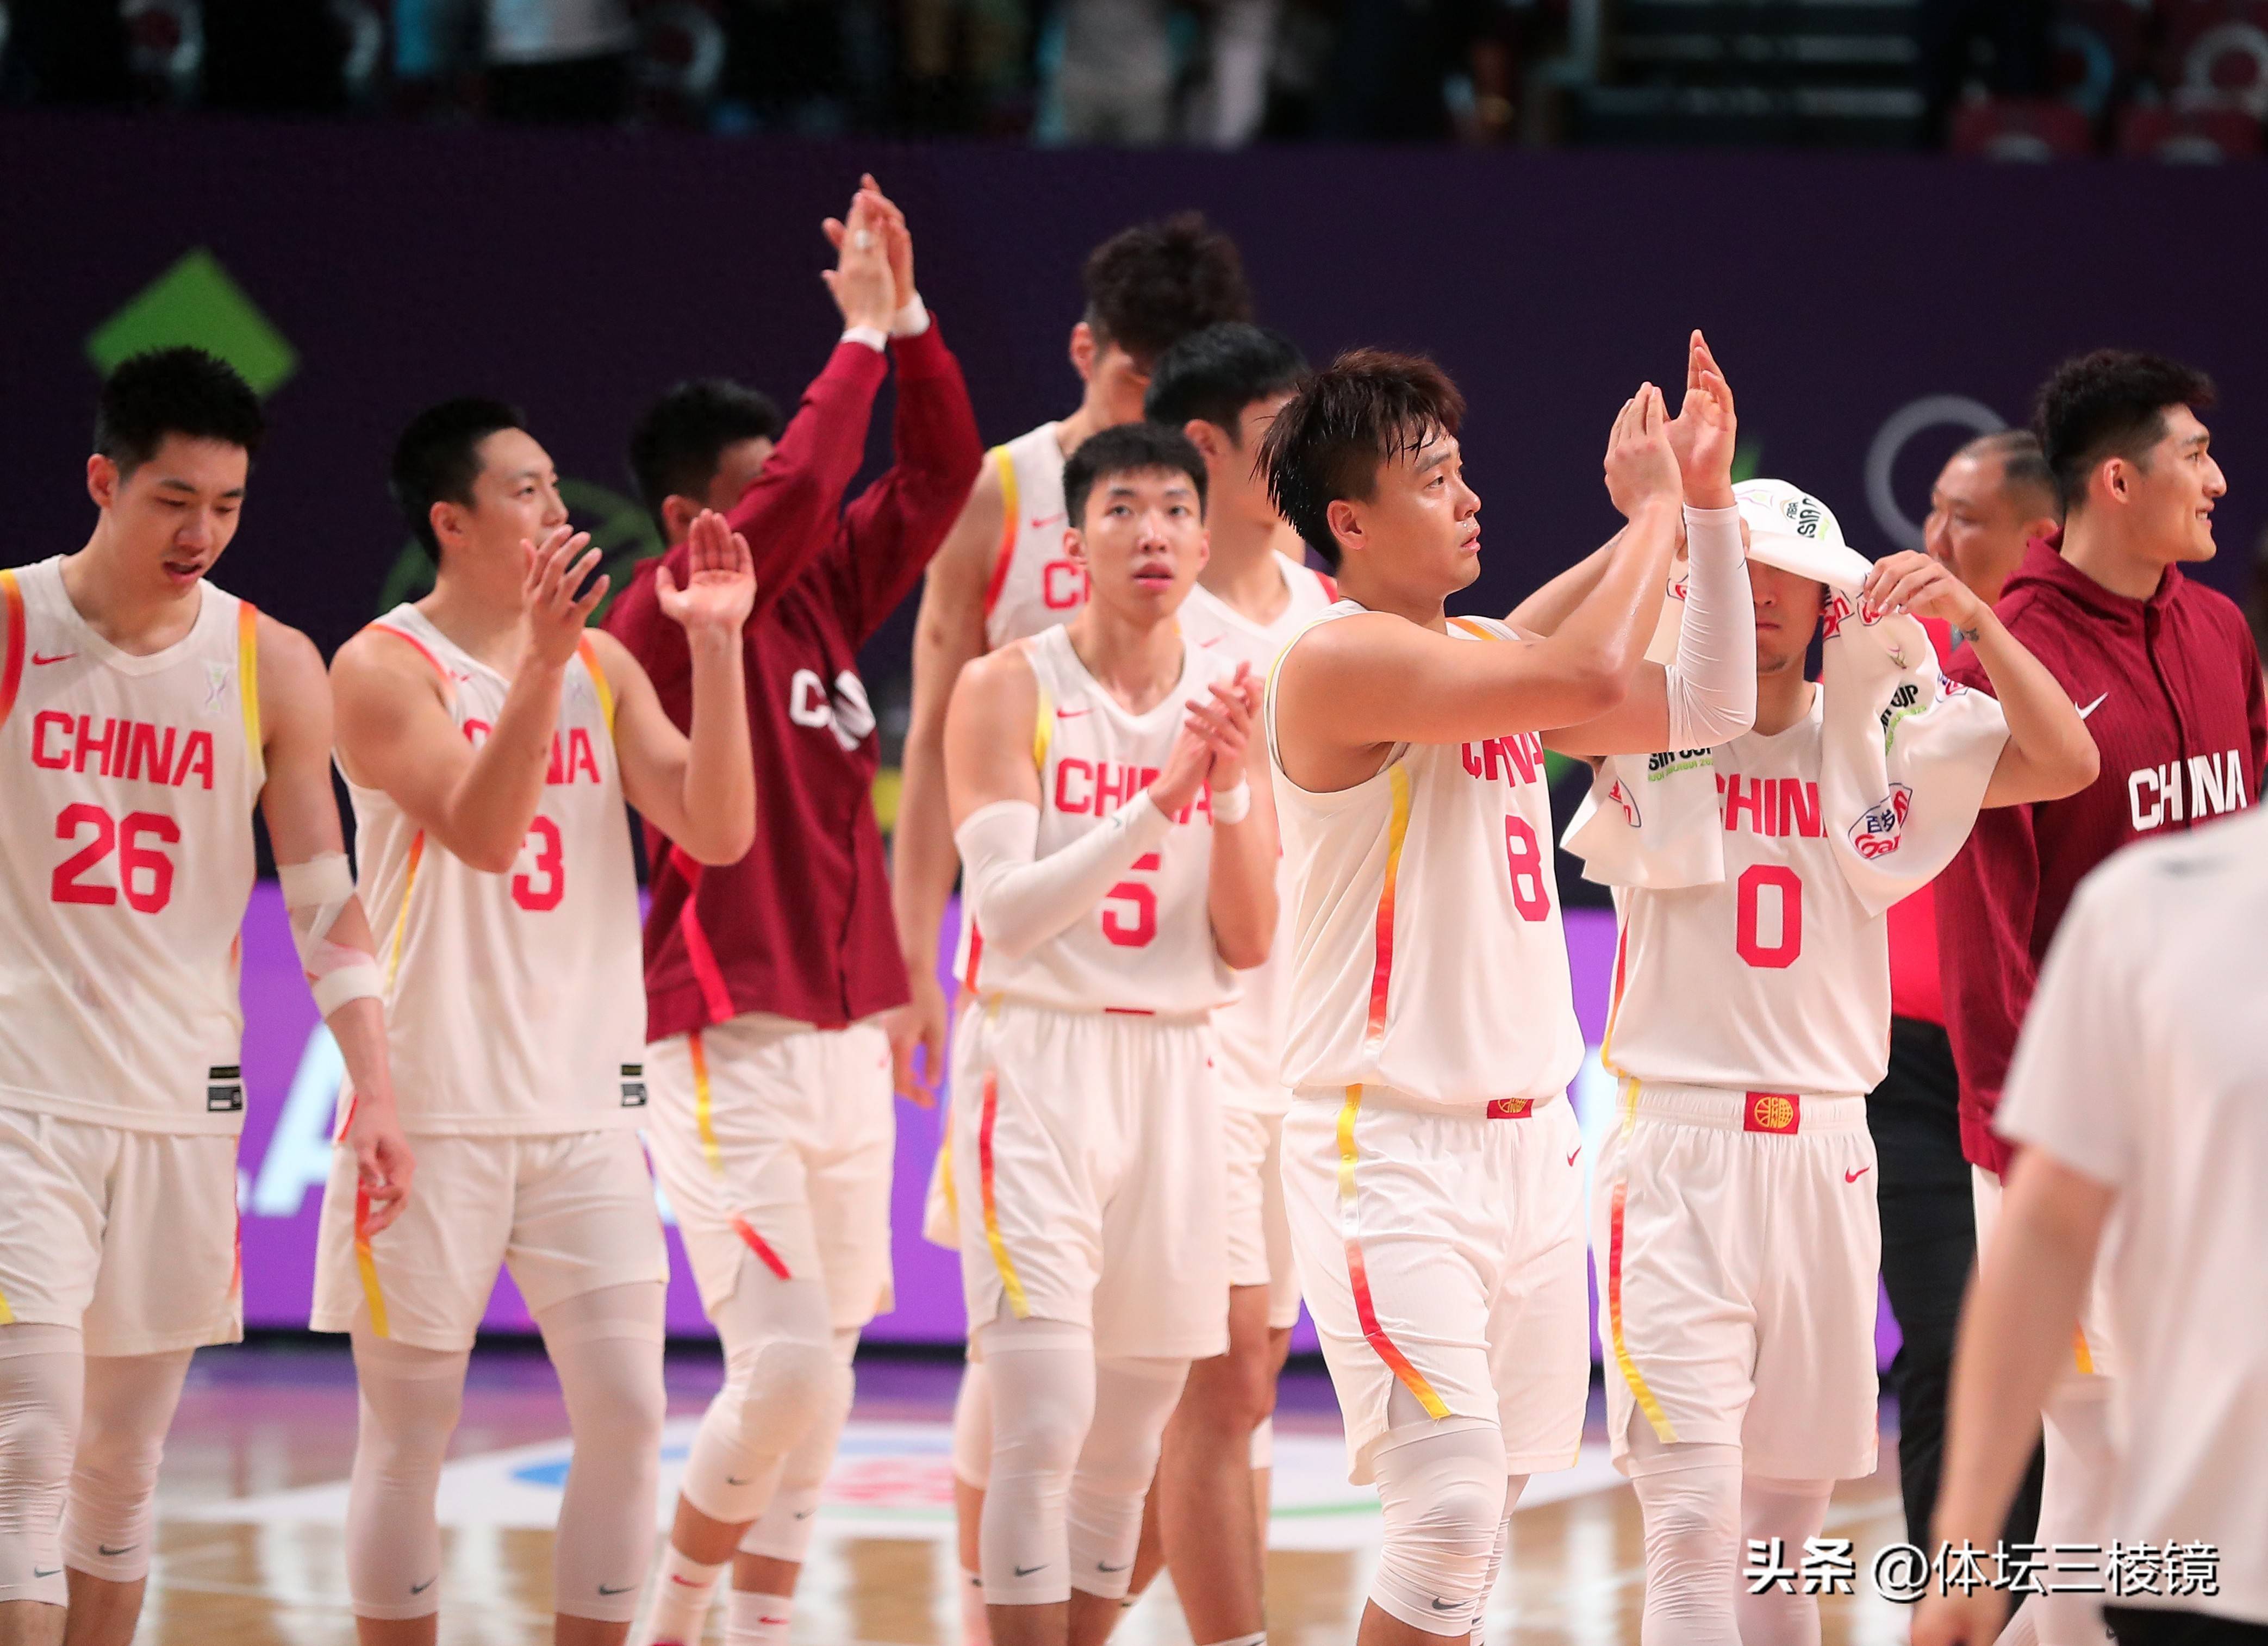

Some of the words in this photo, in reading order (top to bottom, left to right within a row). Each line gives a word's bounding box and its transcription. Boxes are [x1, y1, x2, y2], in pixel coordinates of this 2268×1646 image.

[32, 710, 214, 789] CHINA
[2127, 750, 2247, 832] CHINA
[1716, 774, 1828, 838] HIN
[51, 802, 180, 915] 26
[512, 815, 564, 912] 3
[1103, 853, 1161, 947] 5
[1505, 814, 1550, 921] 8
[1737, 864, 1802, 969] 0
